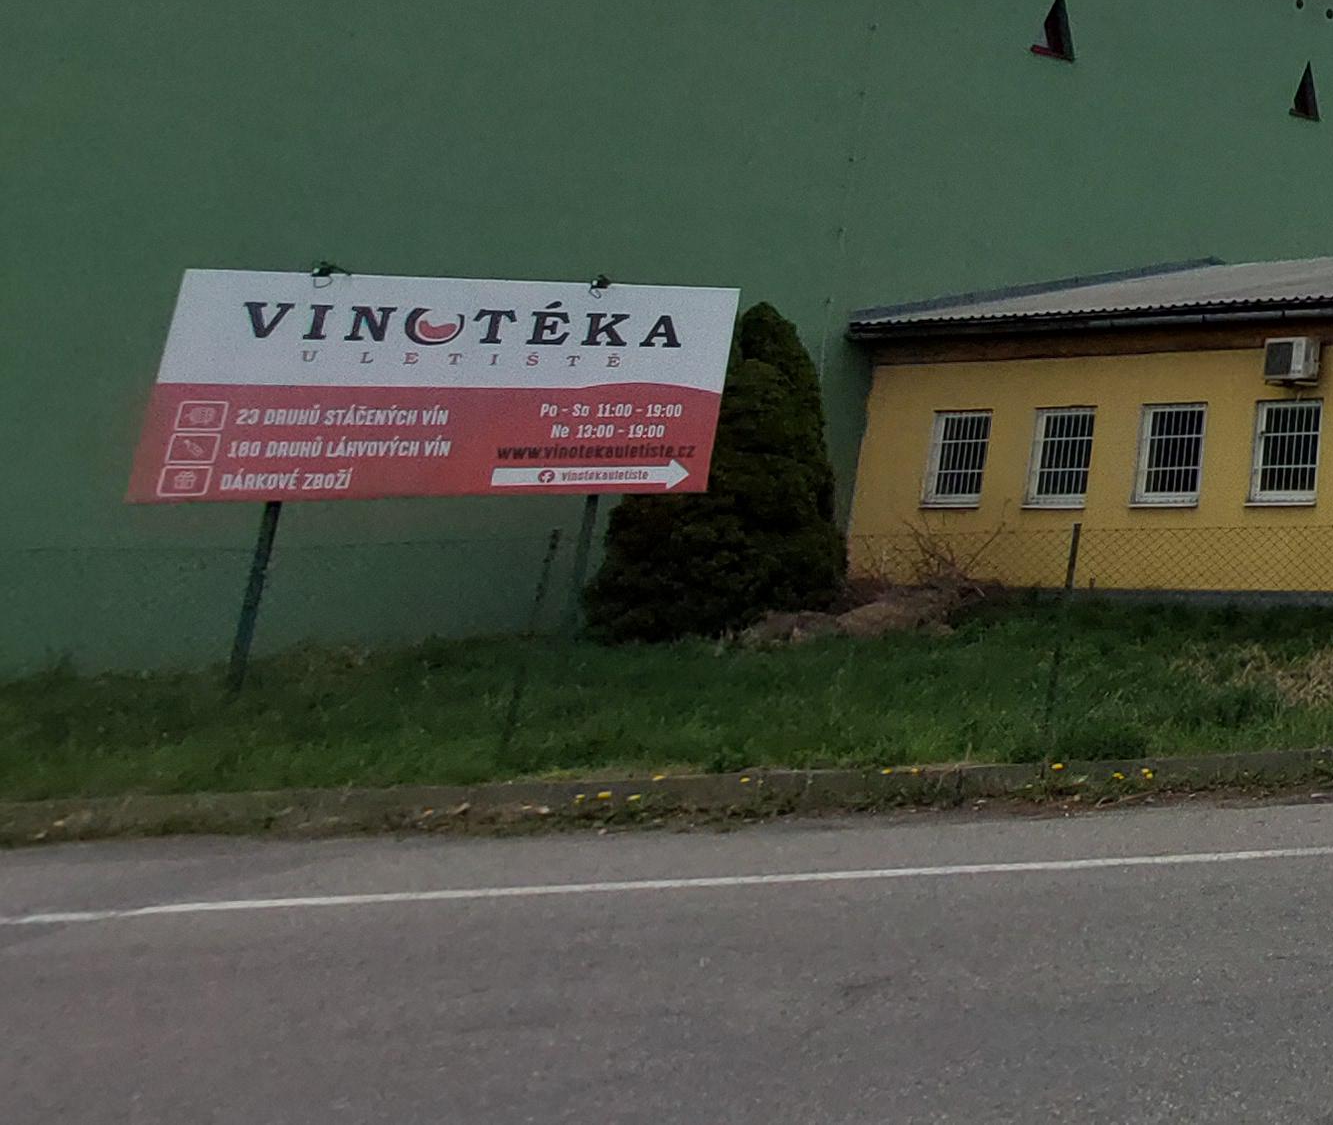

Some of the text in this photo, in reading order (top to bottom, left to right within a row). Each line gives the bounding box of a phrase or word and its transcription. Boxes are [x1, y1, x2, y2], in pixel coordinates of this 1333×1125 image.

[243, 300, 682, 349] VINOTÉKA
[302, 350, 622, 368] U LETIŠTĚ
[421, 405, 449, 425] VÍN
[540, 403, 558, 418] Po
[597, 404, 632, 417] 11:00
[646, 404, 683, 418] 19:00
[550, 424, 570, 438] Ne
[627, 424, 665, 438] 19:00
[424, 435, 452, 457] VÍN
